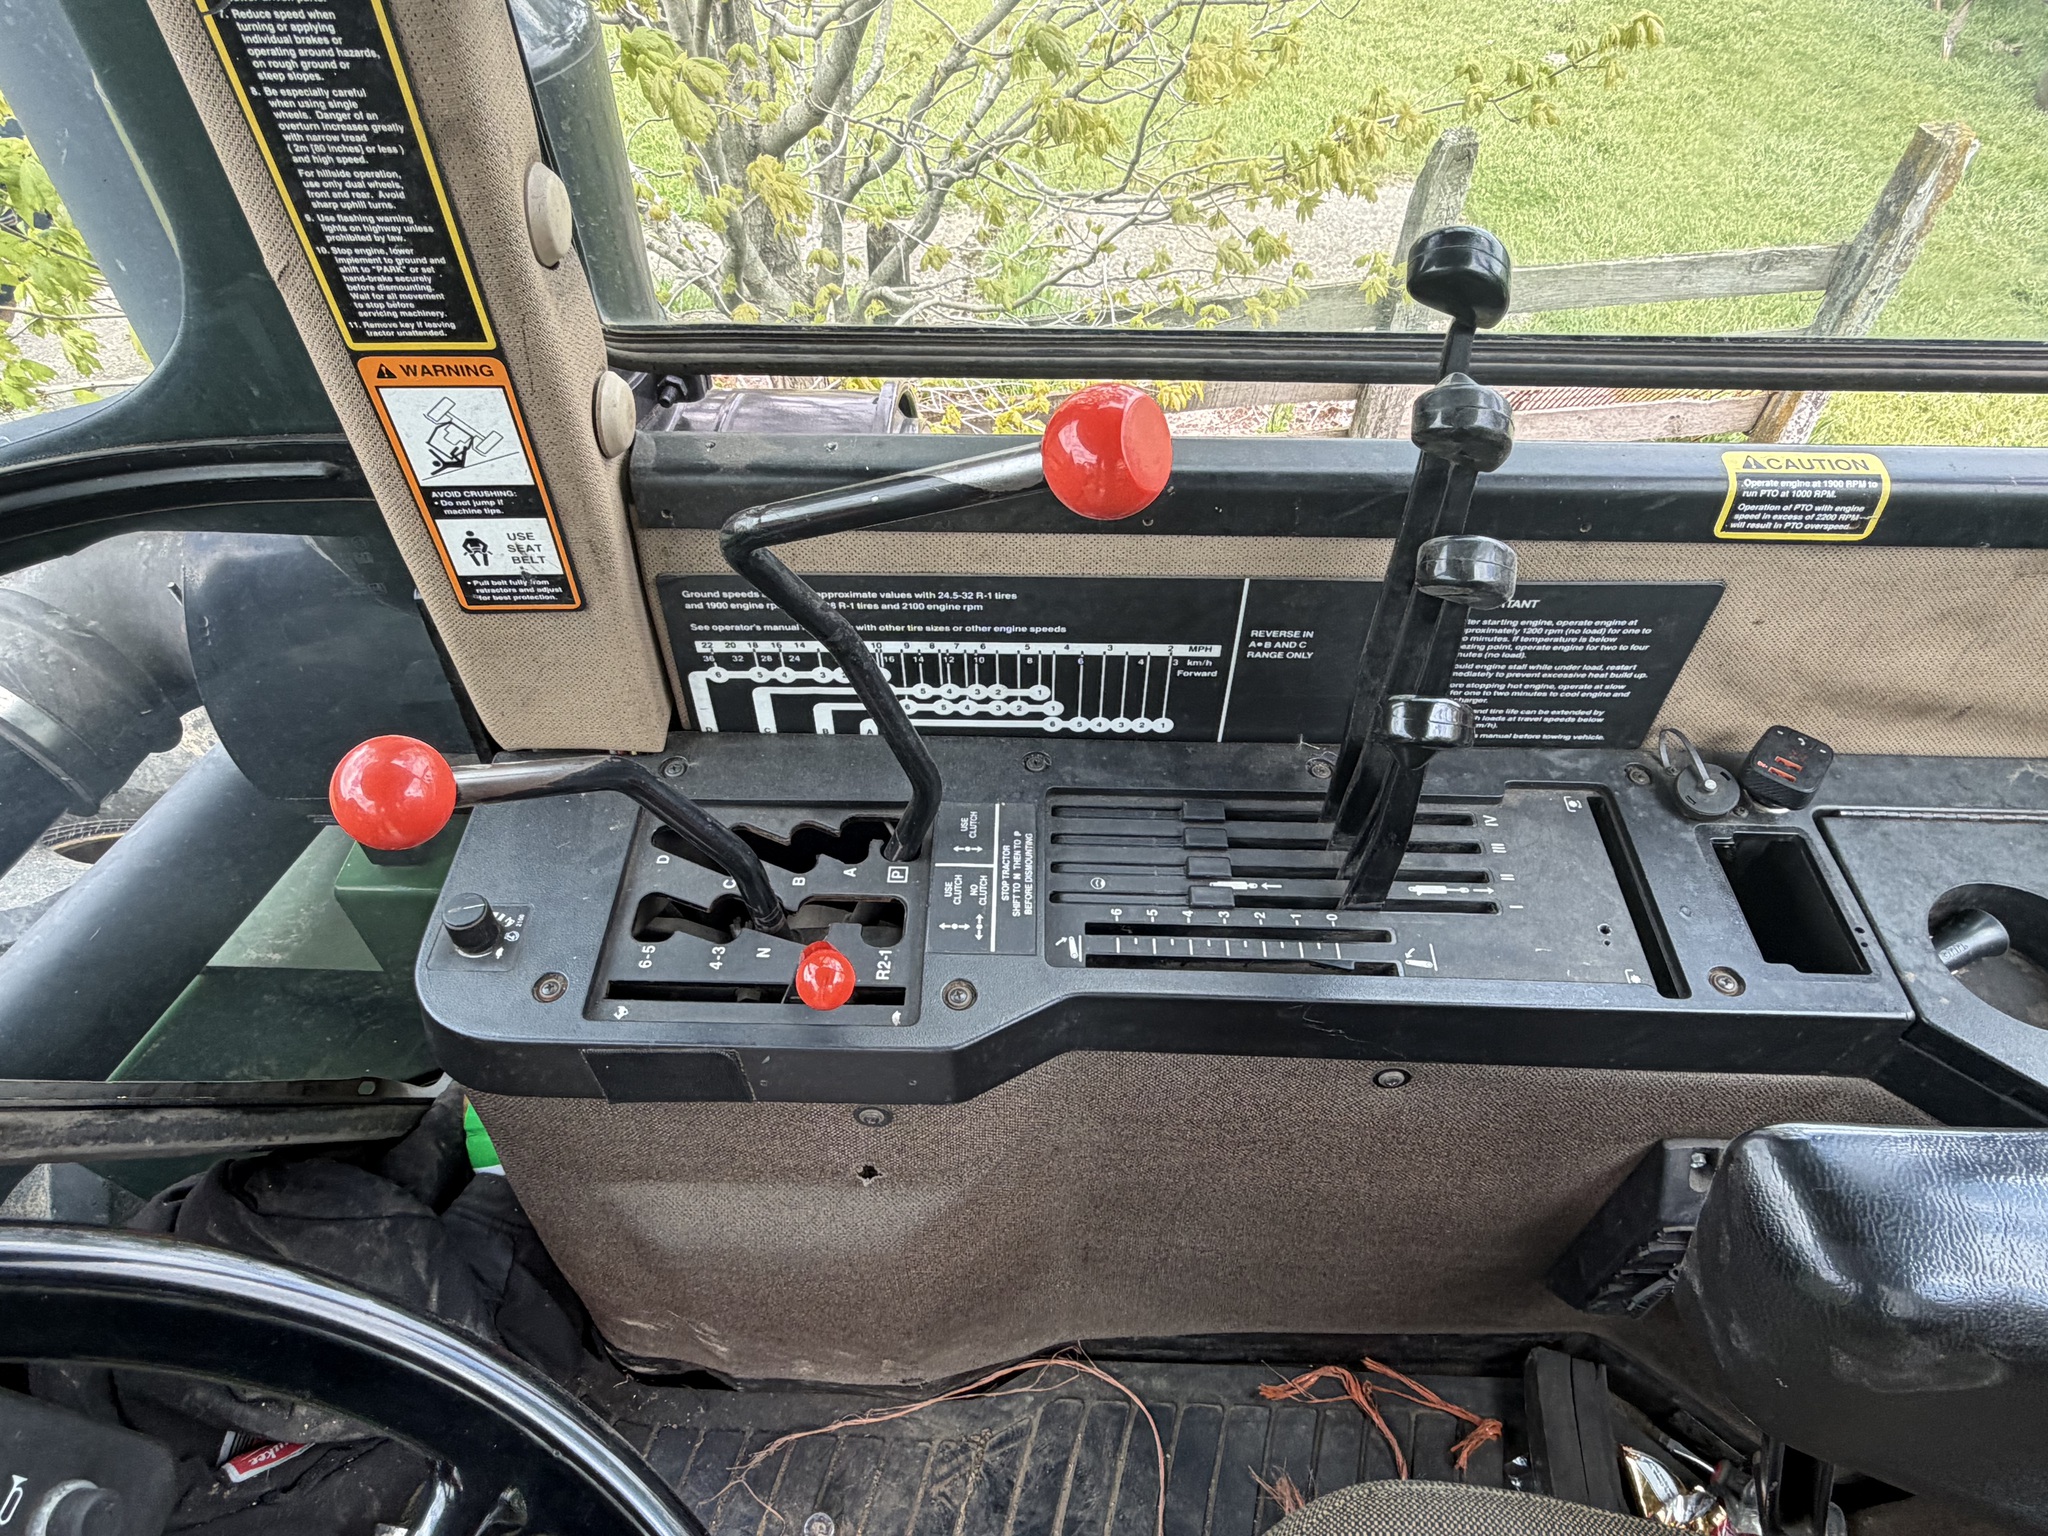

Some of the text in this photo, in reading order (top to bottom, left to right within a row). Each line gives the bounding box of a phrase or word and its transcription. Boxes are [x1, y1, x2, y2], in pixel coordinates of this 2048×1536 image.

[231, 9, 336, 21] Reduce speed when
[236, 22, 335, 34] turning or applying
[242, 34, 343, 45] individual brakes or
[247, 48, 380, 59] operating around hazards,
[331, 247, 352, 256] Stop
[399, 364, 494, 377] WARNING
[1766, 458, 1869, 471] CAUTION
[1744, 479, 1778, 488] Operate
[1781, 480, 1810, 488] engine
[1846, 480, 1866, 488] RPM
[1738, 504, 1780, 512] Operation
[507, 544, 541, 552] SEAT
[511, 556, 545, 564] BELT
[722, 591, 760, 599] speeds
[927, 603, 960, 612] engine
[1482, 619, 1518, 627] starting
[712, 624, 761, 632] operator's
[1030, 626, 1066, 634] speeds
[1251, 630, 1301, 638] REVERSE
[1187, 659, 1212, 667] km/h
[969, 811, 978, 838] CLUTCH
[1014, 839, 1021, 849] TO
[656, 855, 669, 864] D
[1013, 850, 1021, 870] THEN
[844, 867, 857, 877] A
[892, 870, 904, 879] P
[1001, 845, 1010, 901] STOP TRACTOR
[1024, 833, 1033, 916] BEFORE DISMOUNTING
[723, 879, 736, 888] C
[792, 877, 805, 885] B
[944, 882, 952, 897] USE
[953, 875, 962, 904] CLUTCH
[970, 884, 978, 896] NO
[979, 875, 987, 905] CLUTCH
[1013, 882, 1021, 893] TO
[1012, 894, 1021, 917] SHIFT
[639, 945, 655, 968] 6-5
[756, 948, 771, 957] N
[709, 947, 726, 970] 4-3
[876, 950, 892, 980] R2-1
